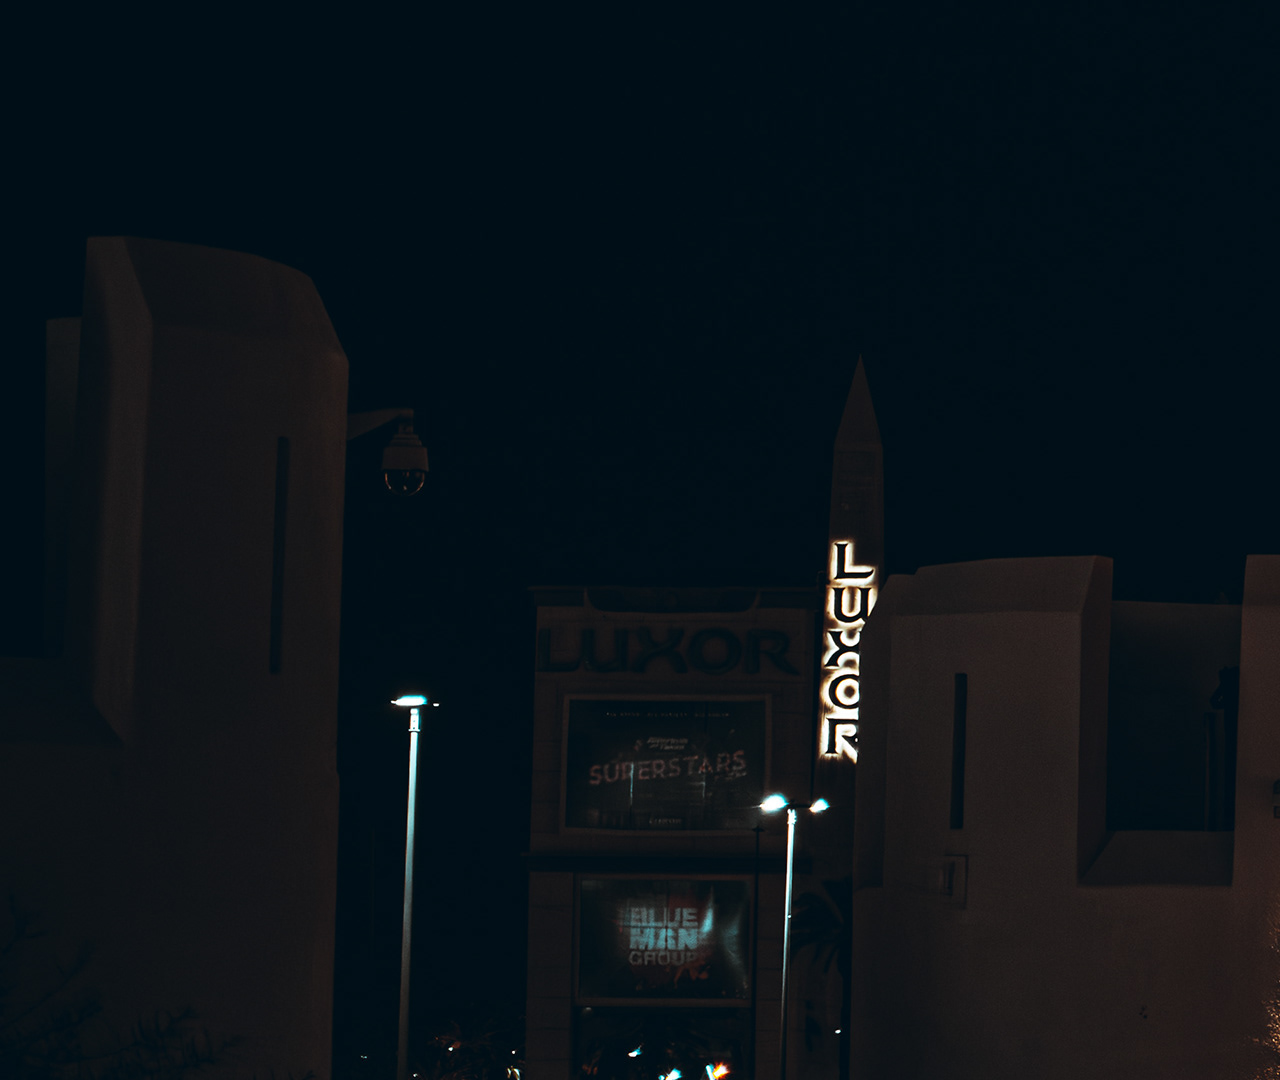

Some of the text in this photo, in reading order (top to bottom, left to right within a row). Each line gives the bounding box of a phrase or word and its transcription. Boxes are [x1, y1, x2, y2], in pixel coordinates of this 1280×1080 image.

[538, 626, 801, 676] LUXOR
[588, 749, 748, 786] SUPERSTARS
[629, 906, 699, 927] BLUE
[628, 927, 699, 951] MAN
[627, 950, 698, 967] GROUP
